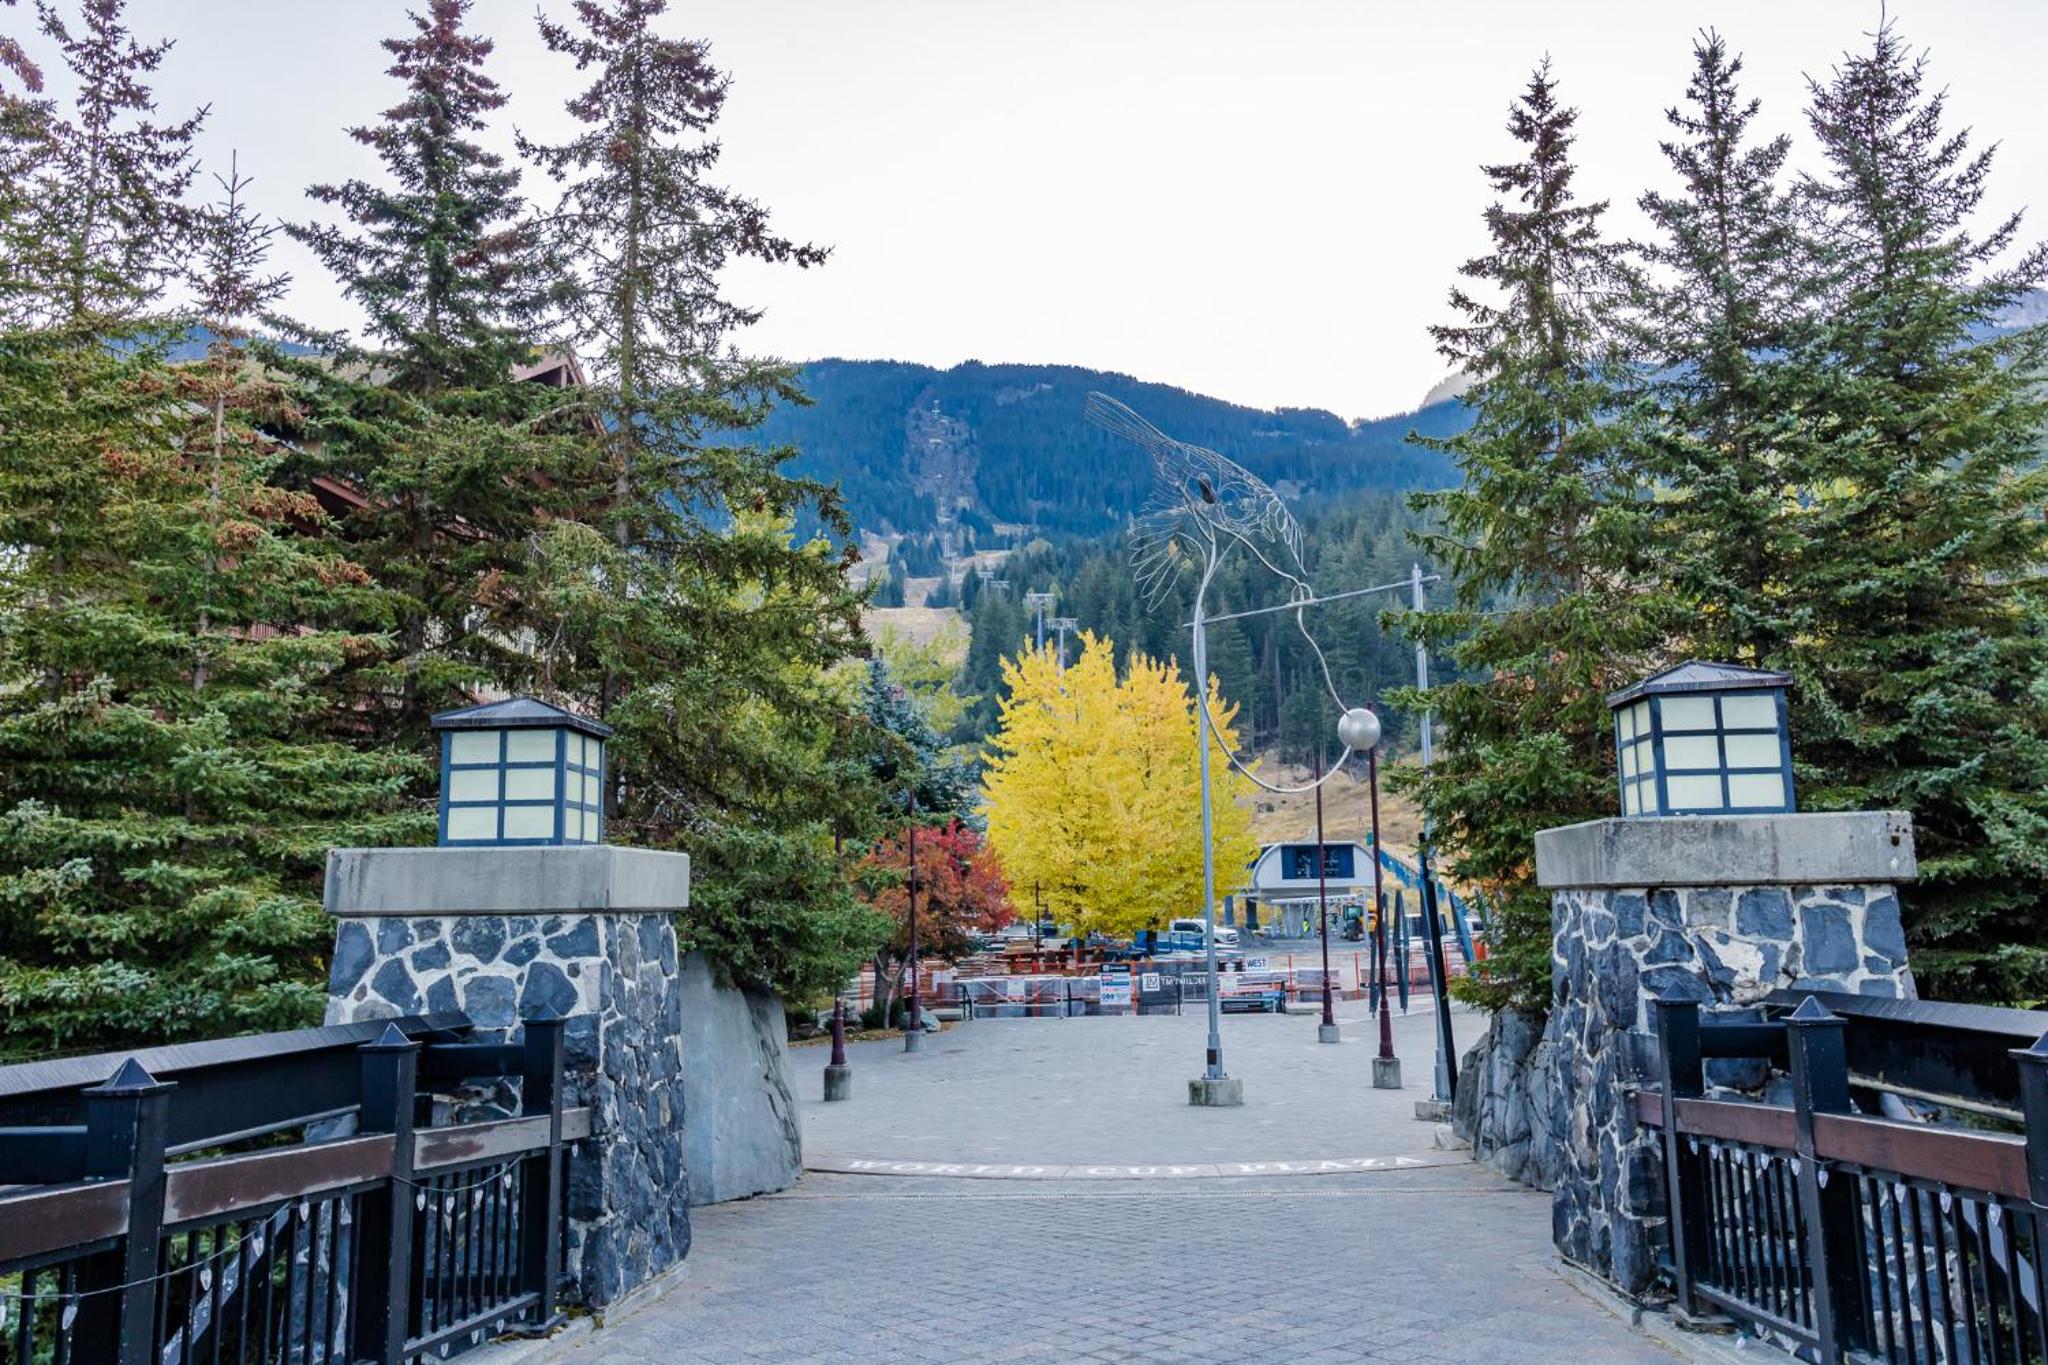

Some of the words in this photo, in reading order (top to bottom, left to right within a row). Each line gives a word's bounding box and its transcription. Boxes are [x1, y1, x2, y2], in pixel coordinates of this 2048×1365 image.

[1246, 959, 1265, 968] WEST
[850, 1159, 1045, 1174] WORLD
[1086, 1166, 1199, 1176] CUP
[1236, 1156, 1425, 1172] PLAZA
